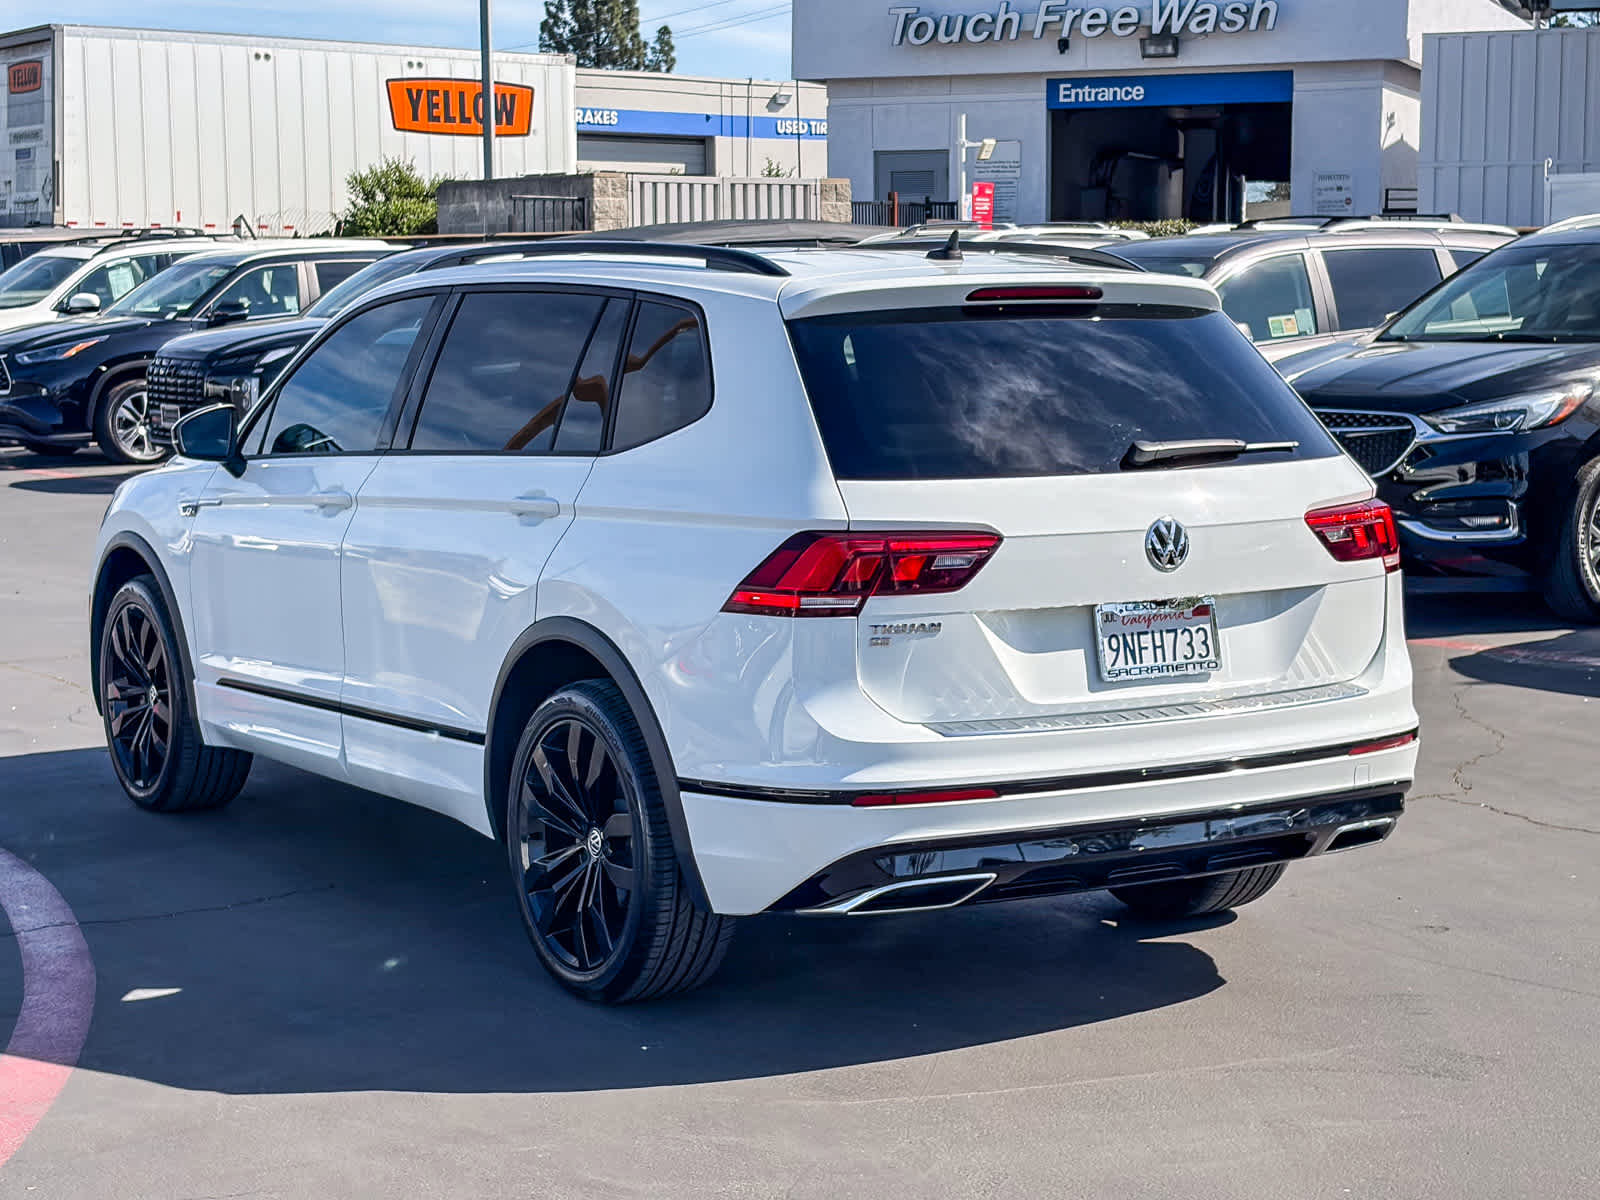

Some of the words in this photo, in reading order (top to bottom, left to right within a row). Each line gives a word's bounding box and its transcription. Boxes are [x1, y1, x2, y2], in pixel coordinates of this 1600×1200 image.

[889, 1, 1022, 47] Touch
[1032, 0, 1139, 39] Free
[1151, 0, 1279, 35] Wash
[1059, 83, 1145, 102] Entrance
[776, 119, 809, 135] USED
[1121, 610, 1193, 629] California
[1107, 626, 1211, 668] 9NFH733
[1107, 660, 1219, 679] SACRAMENTO
